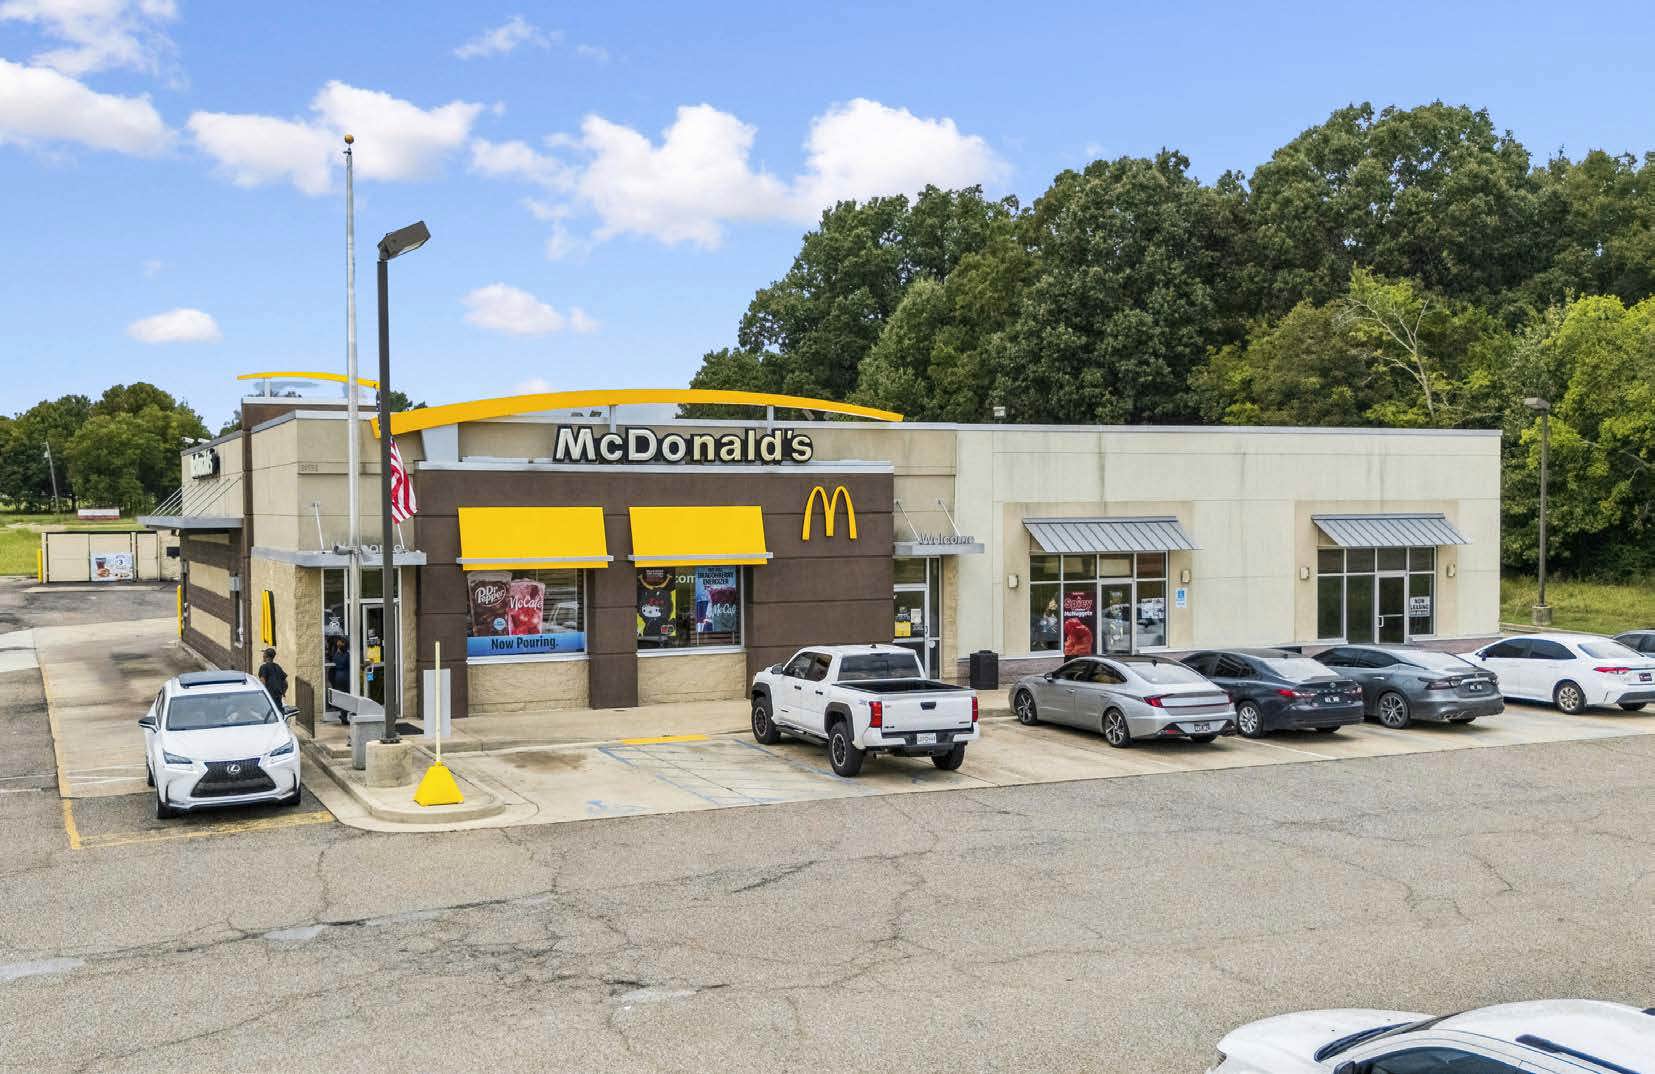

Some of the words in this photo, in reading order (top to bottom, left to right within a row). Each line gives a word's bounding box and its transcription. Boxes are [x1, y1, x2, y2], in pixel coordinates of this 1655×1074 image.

[554, 427, 814, 463] McDonald's
[919, 531, 976, 545] Welcome
[477, 587, 505, 604] Pepper
[1064, 597, 1094, 611] Spicy
[491, 638, 514, 650] Now
[516, 635, 560, 650] Pouring.
